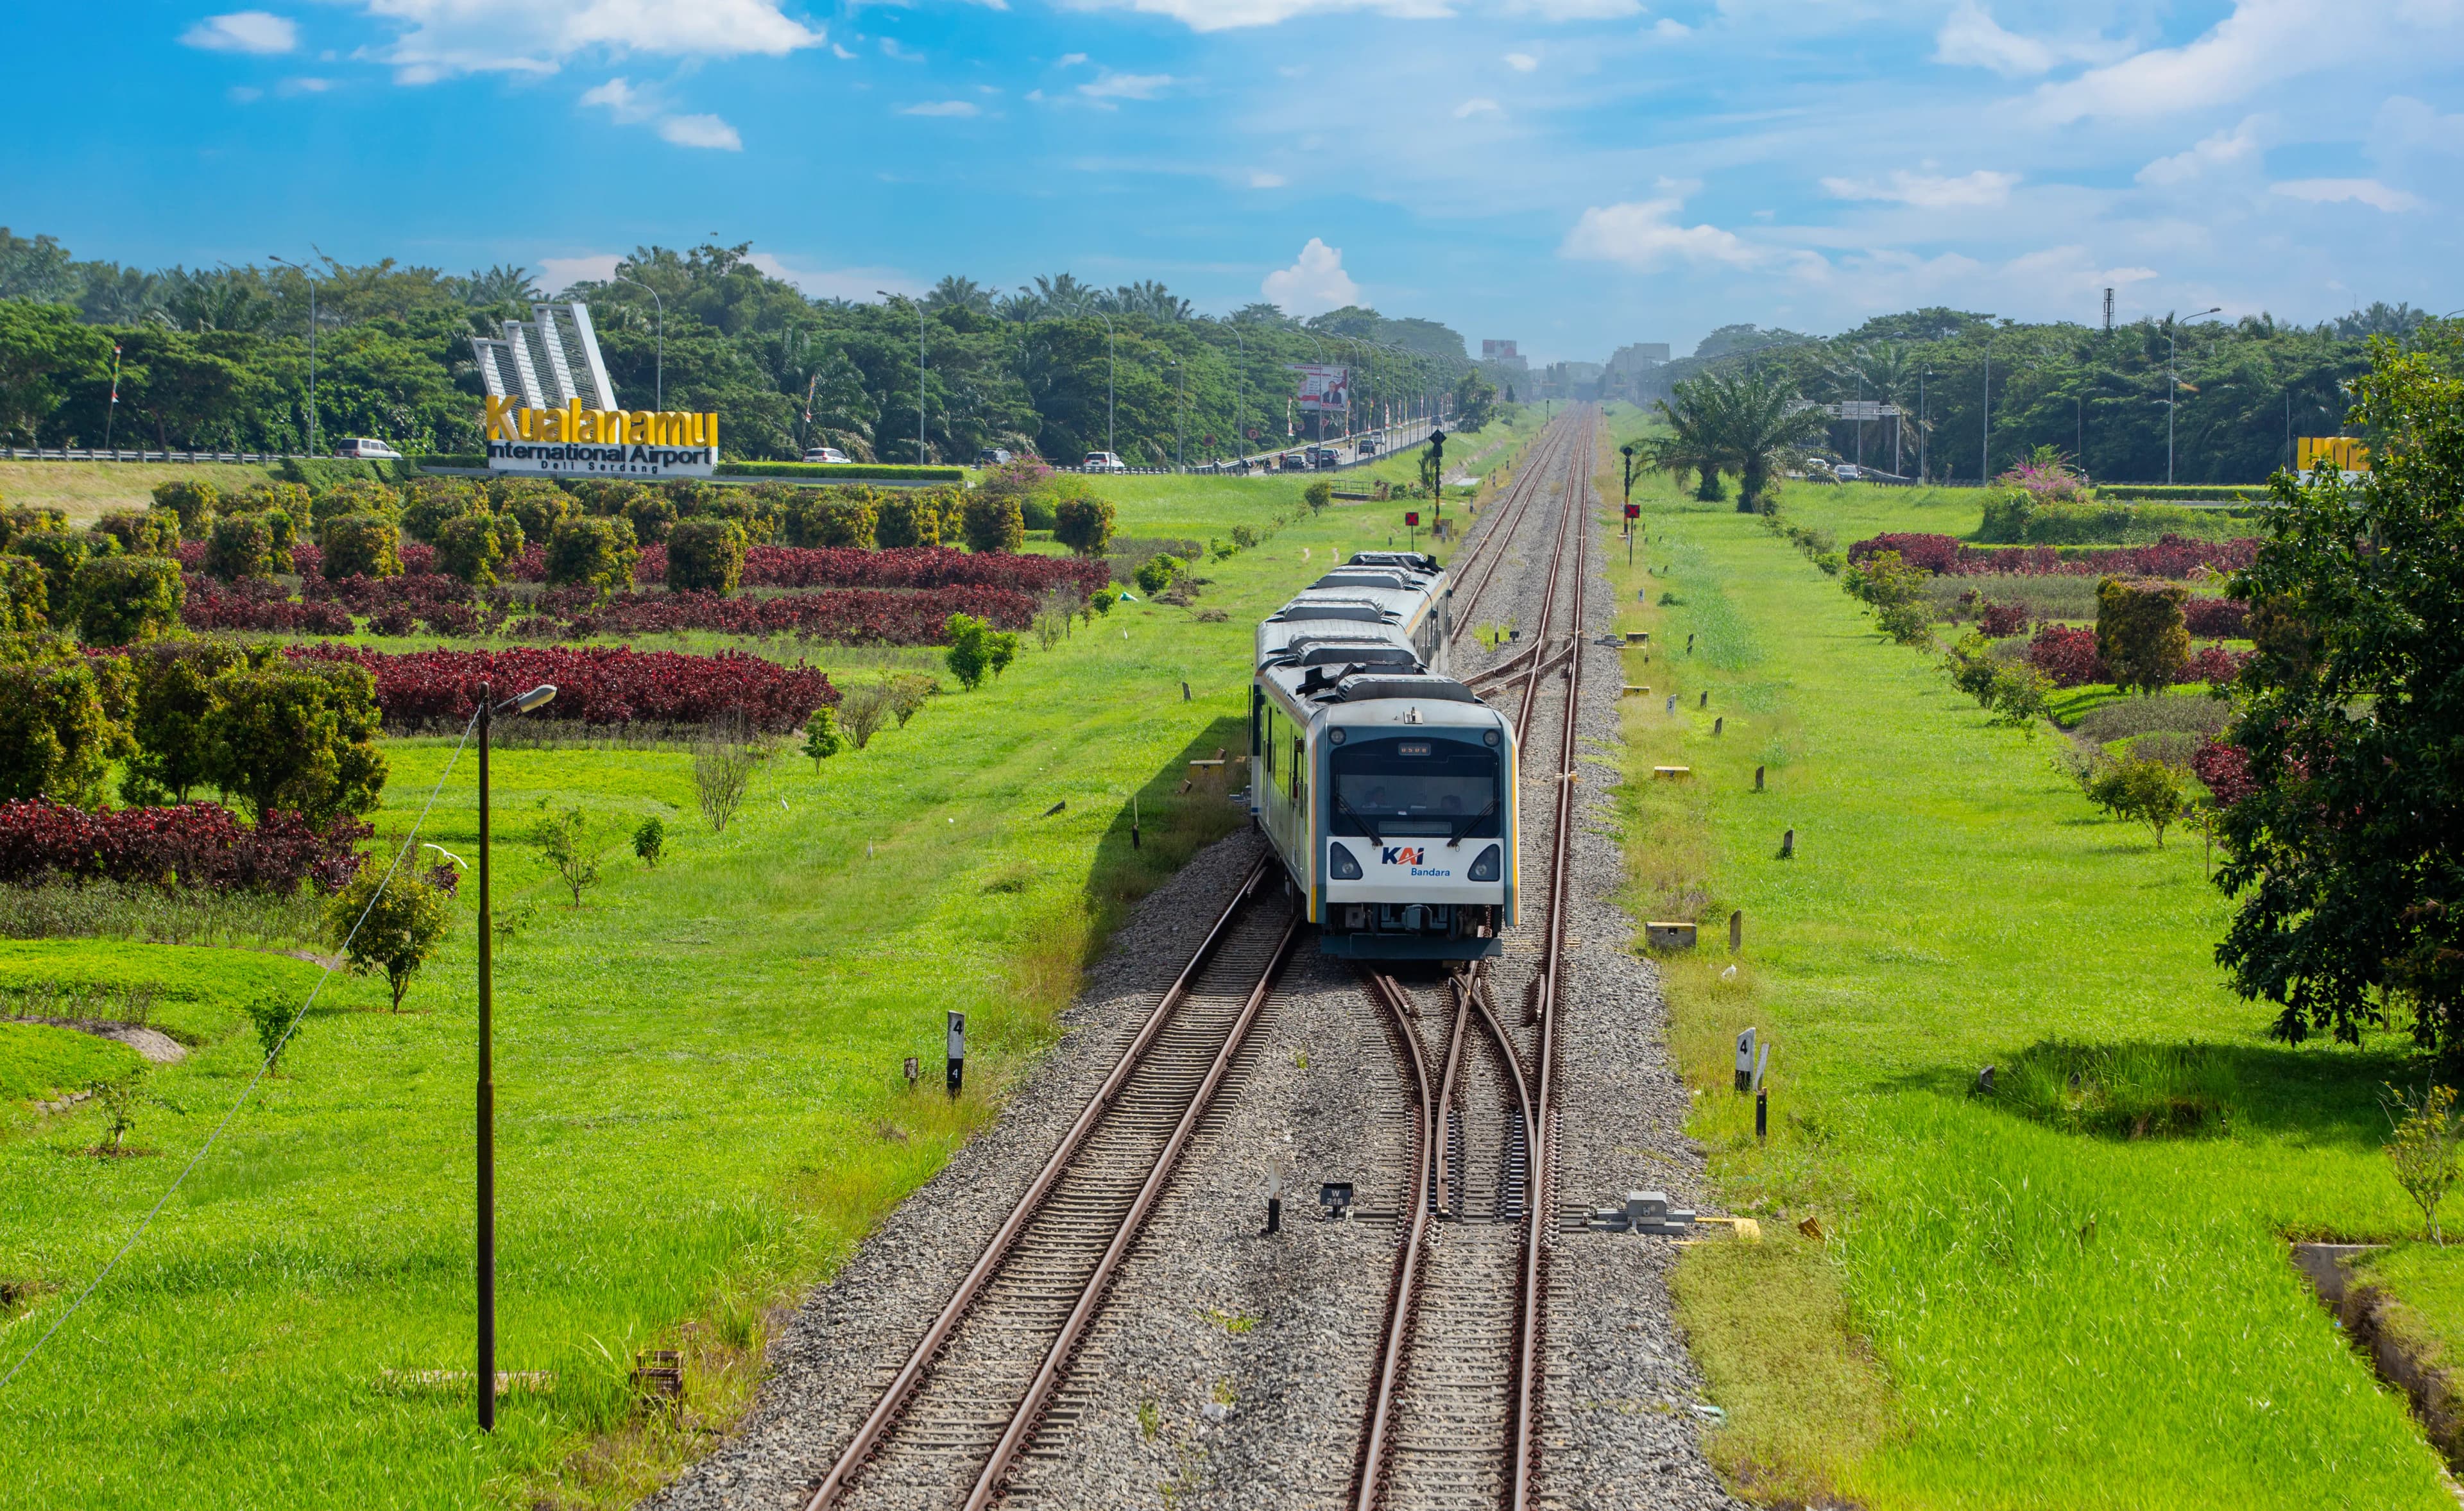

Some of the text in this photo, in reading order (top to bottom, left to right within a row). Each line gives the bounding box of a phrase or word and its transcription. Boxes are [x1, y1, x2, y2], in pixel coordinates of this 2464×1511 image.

[486, 395, 718, 447] Kualanamu
[487, 441, 710, 467] International Airport
[541, 460, 658, 474] Deli Serdang
[1382, 847, 1424, 865] KAI
[1411, 867, 1450, 876] Bandara
[953, 1020, 963, 1035] 4
[1740, 1039, 1747, 1055] 4
[952, 1068, 958, 1079] 4
